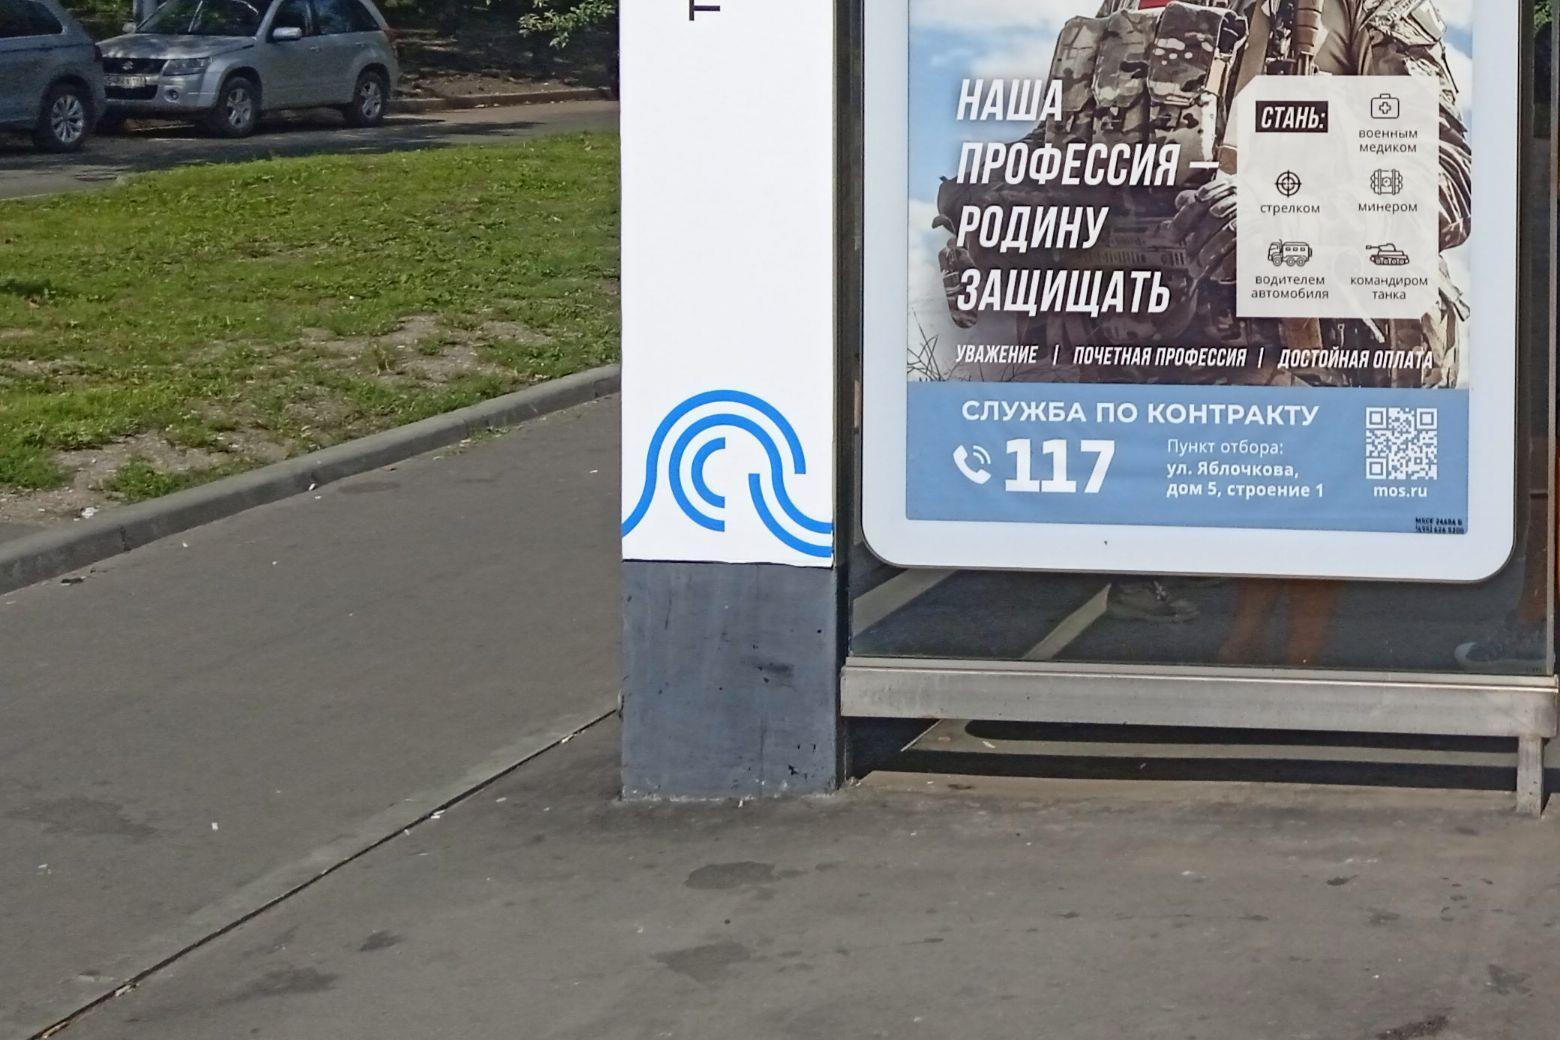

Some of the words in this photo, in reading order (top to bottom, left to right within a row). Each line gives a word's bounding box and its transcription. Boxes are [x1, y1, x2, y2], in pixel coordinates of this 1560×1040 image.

[956, 78, 1063, 121] НАША
[1261, 106, 1325, 129] СТАНЬ:
[1358, 129, 1418, 139] военным
[1359, 143, 1417, 153] медиком
[957, 141, 1182, 186] ПРОФЕССИЯ
[1260, 203, 1321, 216] стрелком
[1358, 202, 1418, 215] минером
[956, 205, 1110, 253] РОДИНУ
[1255, 275, 1325, 287] водителем
[1350, 276, 1428, 289] командиром
[957, 269, 1171, 318] ЗАЩИЩАТЬ
[1251, 287, 1329, 299] автомобиля
[1373, 290, 1406, 300] танка
[955, 344, 1039, 365] УВАЖЕНИЕ
[1073, 346, 1151, 366] ПОЧЕТНАЯ
[1155, 347, 1248, 367] ПРОФЕССИЯ
[1277, 346, 1370, 369] ДОСТОЙНАЯ
[1373, 349, 1433, 369] ОПЛАТА
[962, 400, 1087, 423] СЛУЖБА
[1096, 402, 1138, 423] ПО
[1147, 403, 1320, 426] КОНТРАКТУ
[1167, 438, 1215, 455] Пункт
[1220, 439, 1284, 458] отбора:
[1005, 438, 1115, 494] 117
[1166, 463, 1192, 478] ул.
[1197, 461, 1299, 479] Яблочкова,
[1166, 482, 1202, 497] дом
[1207, 481, 1221, 498] 5,
[1227, 483, 1310, 500] строение
[1315, 483, 1324, 497] 1
[1373, 485, 1428, 498] mos.ru
